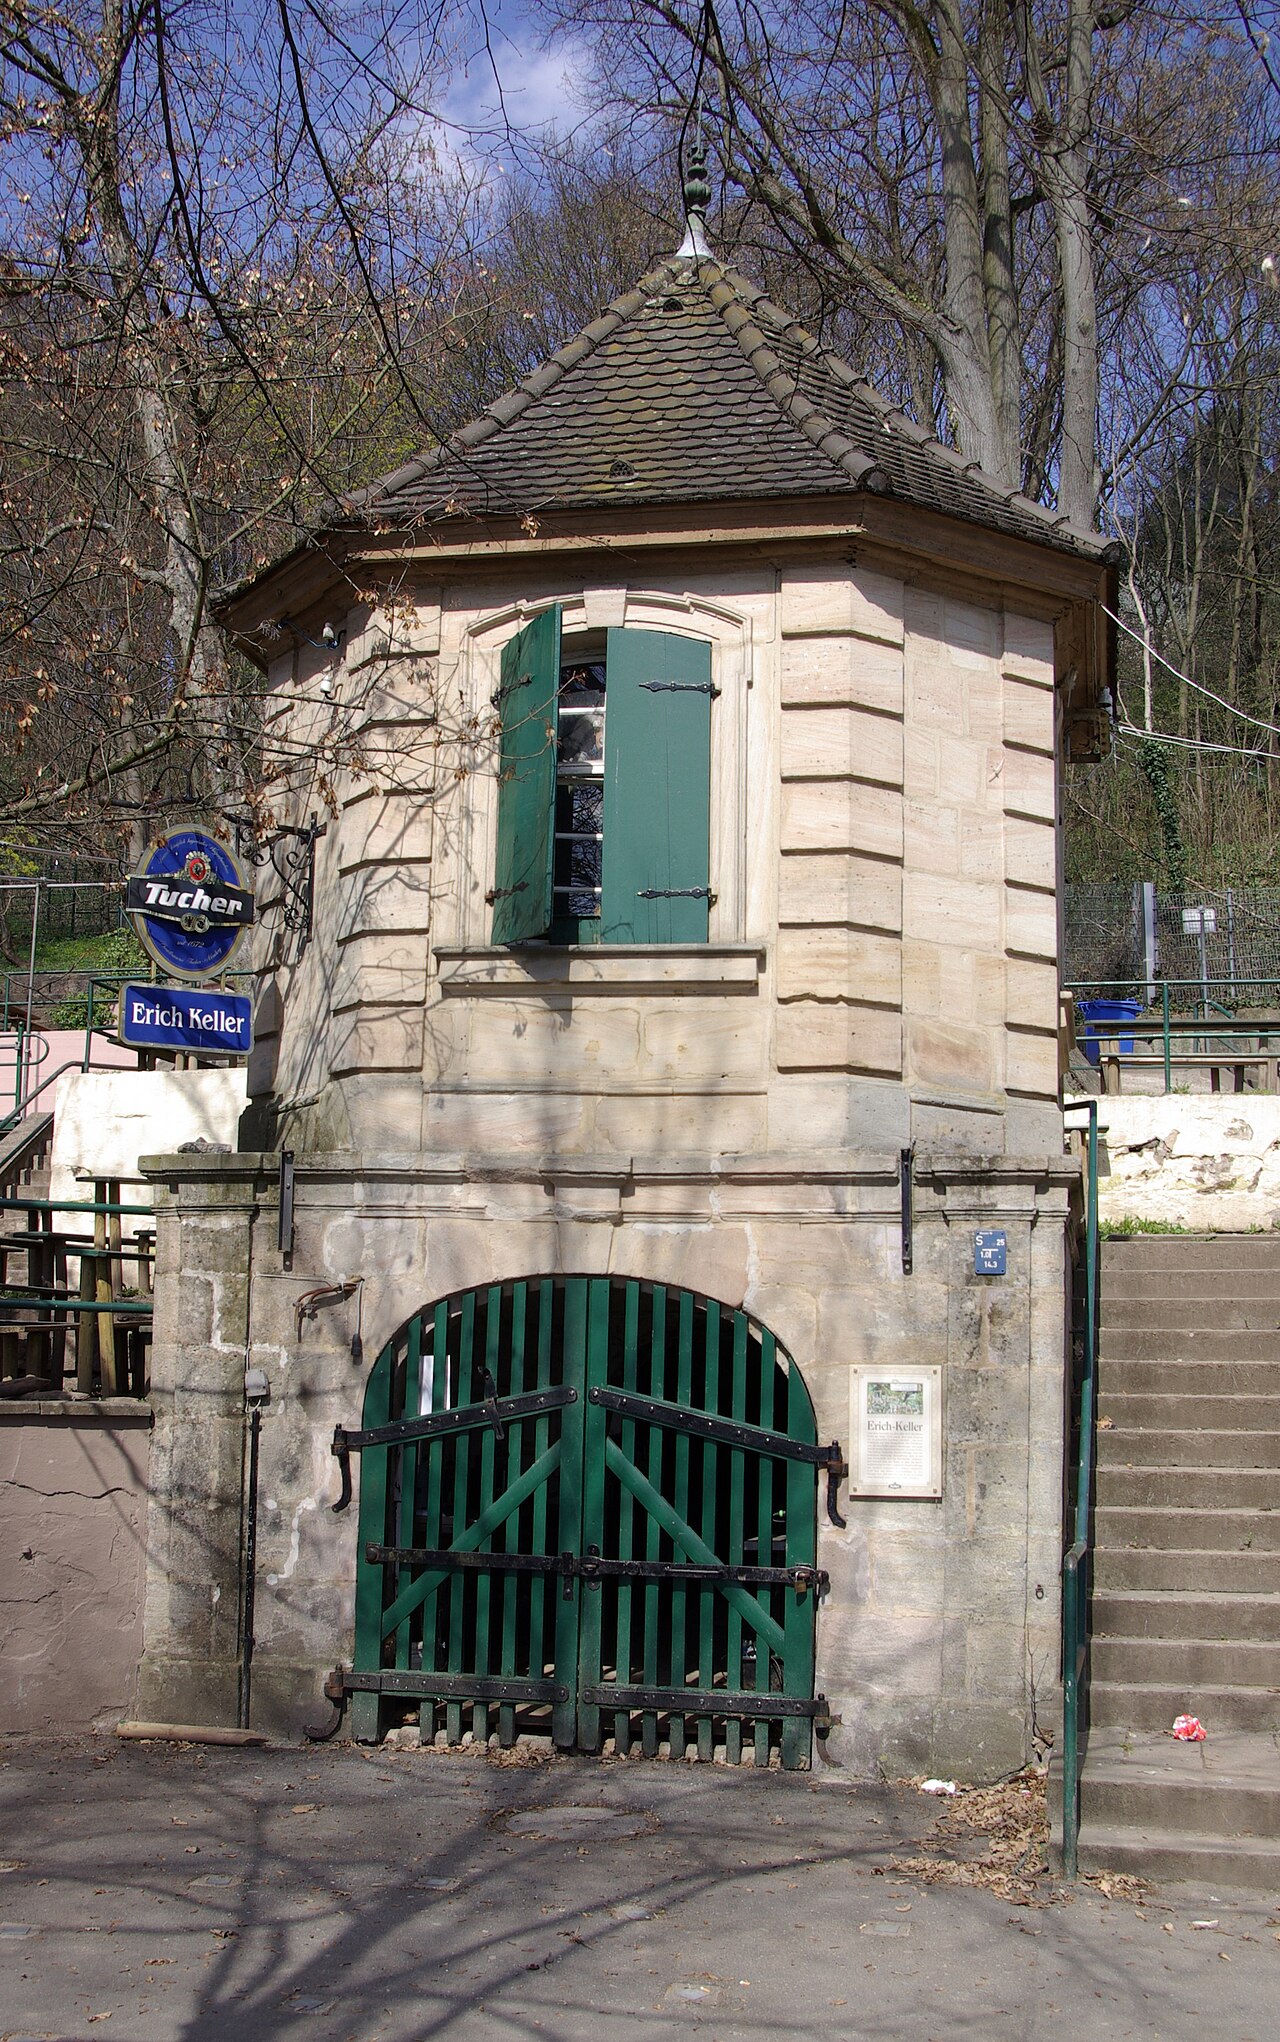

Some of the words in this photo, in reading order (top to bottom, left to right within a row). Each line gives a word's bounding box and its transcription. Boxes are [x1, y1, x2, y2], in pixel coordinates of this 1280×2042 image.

[145, 882, 243, 916] Tucher
[131, 1001, 183, 1028] Erich
[189, 1007, 245, 1034] Keller
[976, 1235, 983, 1246] S
[996, 1238, 1005, 1246] 25
[867, 1420, 923, 1432] Erich-Keller
